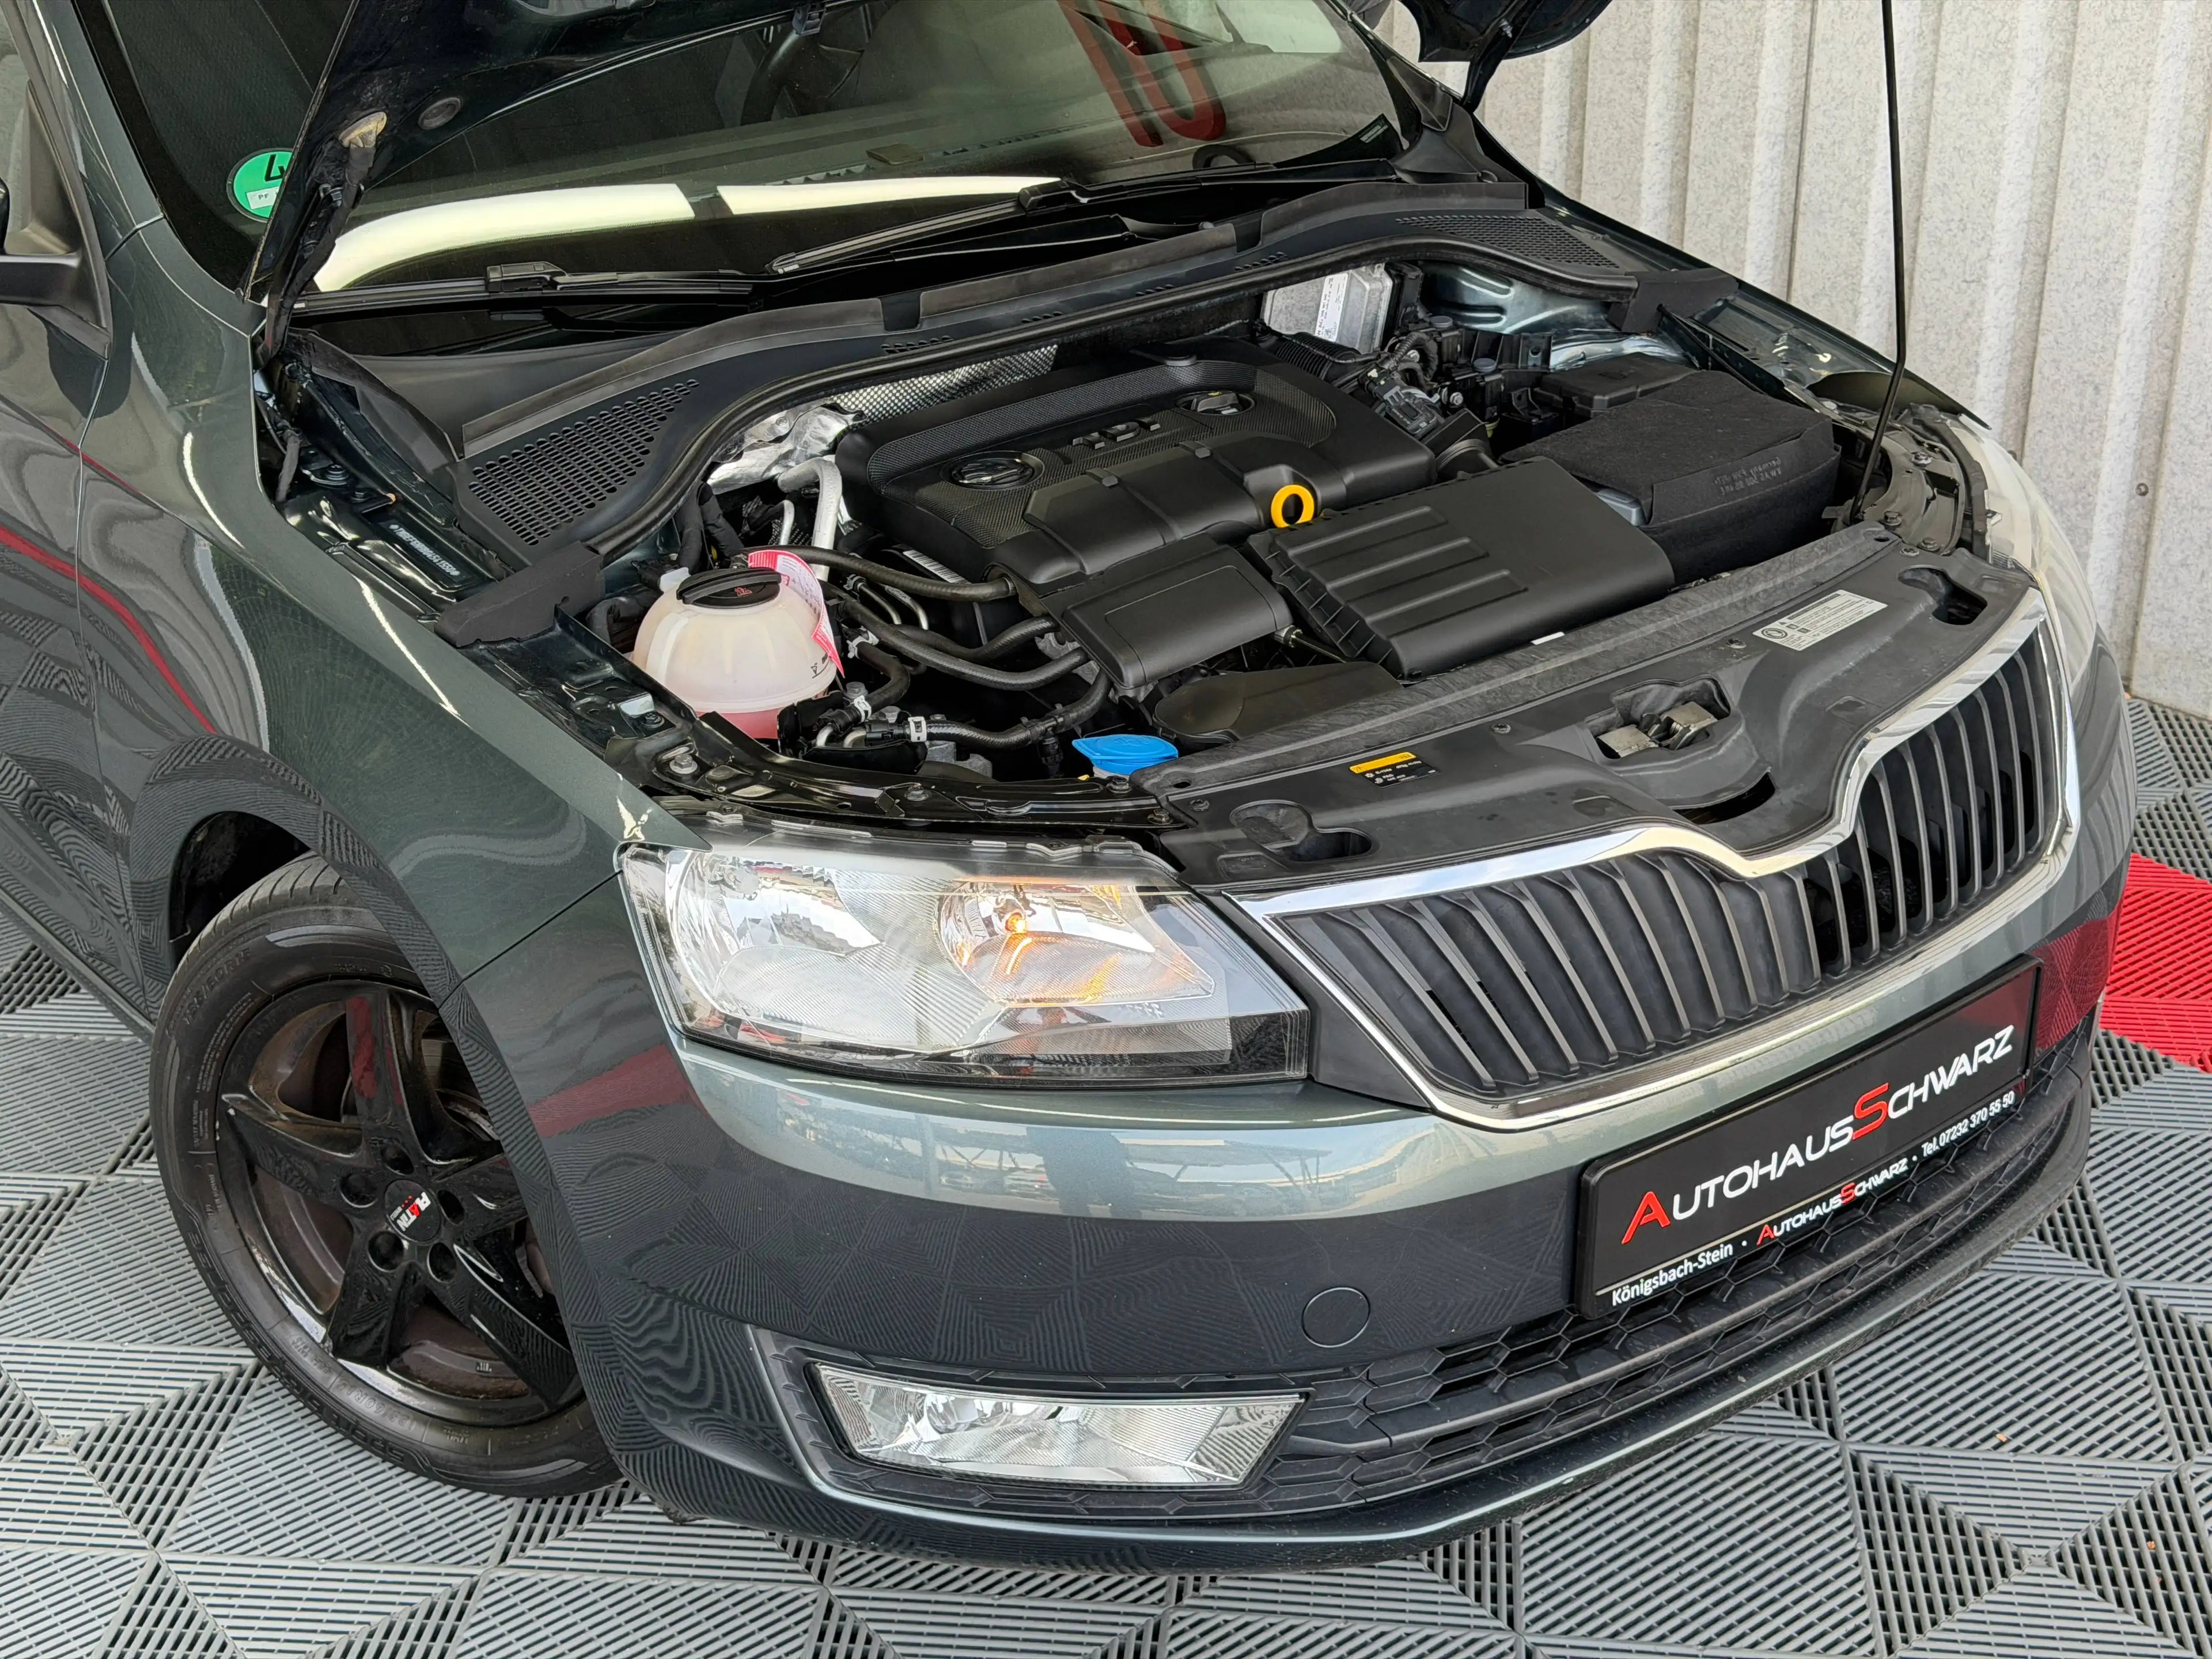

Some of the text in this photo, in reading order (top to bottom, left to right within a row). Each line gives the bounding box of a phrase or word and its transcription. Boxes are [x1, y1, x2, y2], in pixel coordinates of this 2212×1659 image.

[1612, 1244, 1733, 1306] Königsbach-Stein
[1969, 1107, 1988, 1128] 370
[1989, 1098, 2002, 1116] 55
[2002, 1090, 2015, 1108] 50
